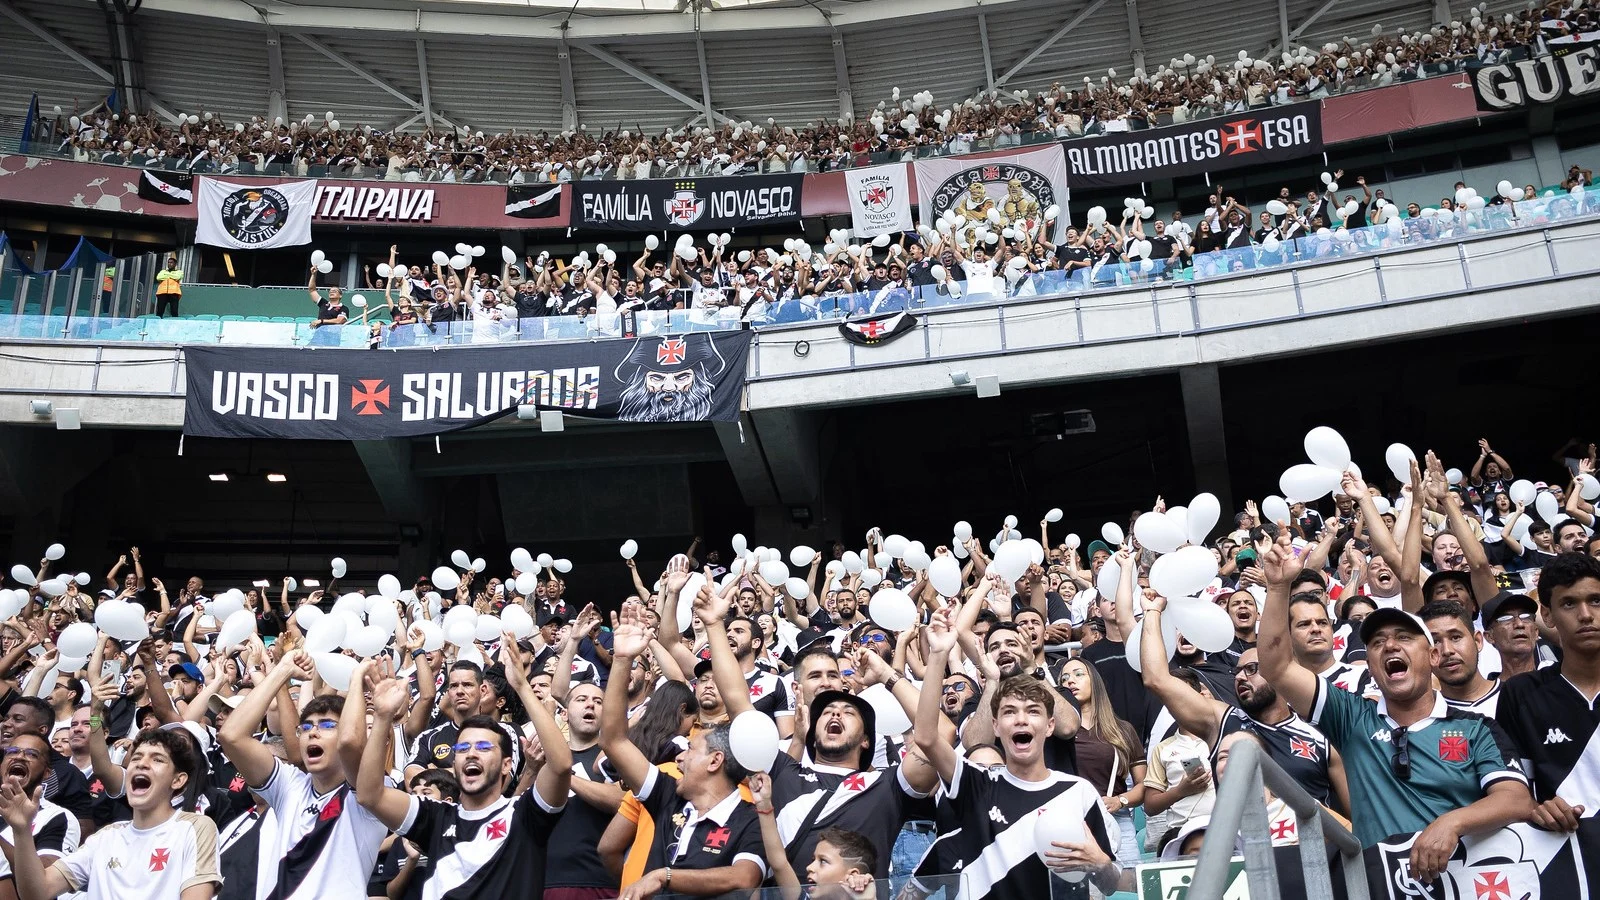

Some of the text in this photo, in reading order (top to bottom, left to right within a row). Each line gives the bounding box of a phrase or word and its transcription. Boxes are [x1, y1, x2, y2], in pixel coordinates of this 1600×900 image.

[1477, 45, 1600, 109] GUE
[1068, 115, 1311, 175] ALMIRANTES FSA
[311, 186, 435, 221] ITAIPAVA
[583, 185, 793, 221] FAMÍLIA NOVASCO
[864, 211, 896, 221] NOVASCO
[213, 370, 339, 421] VASCO
